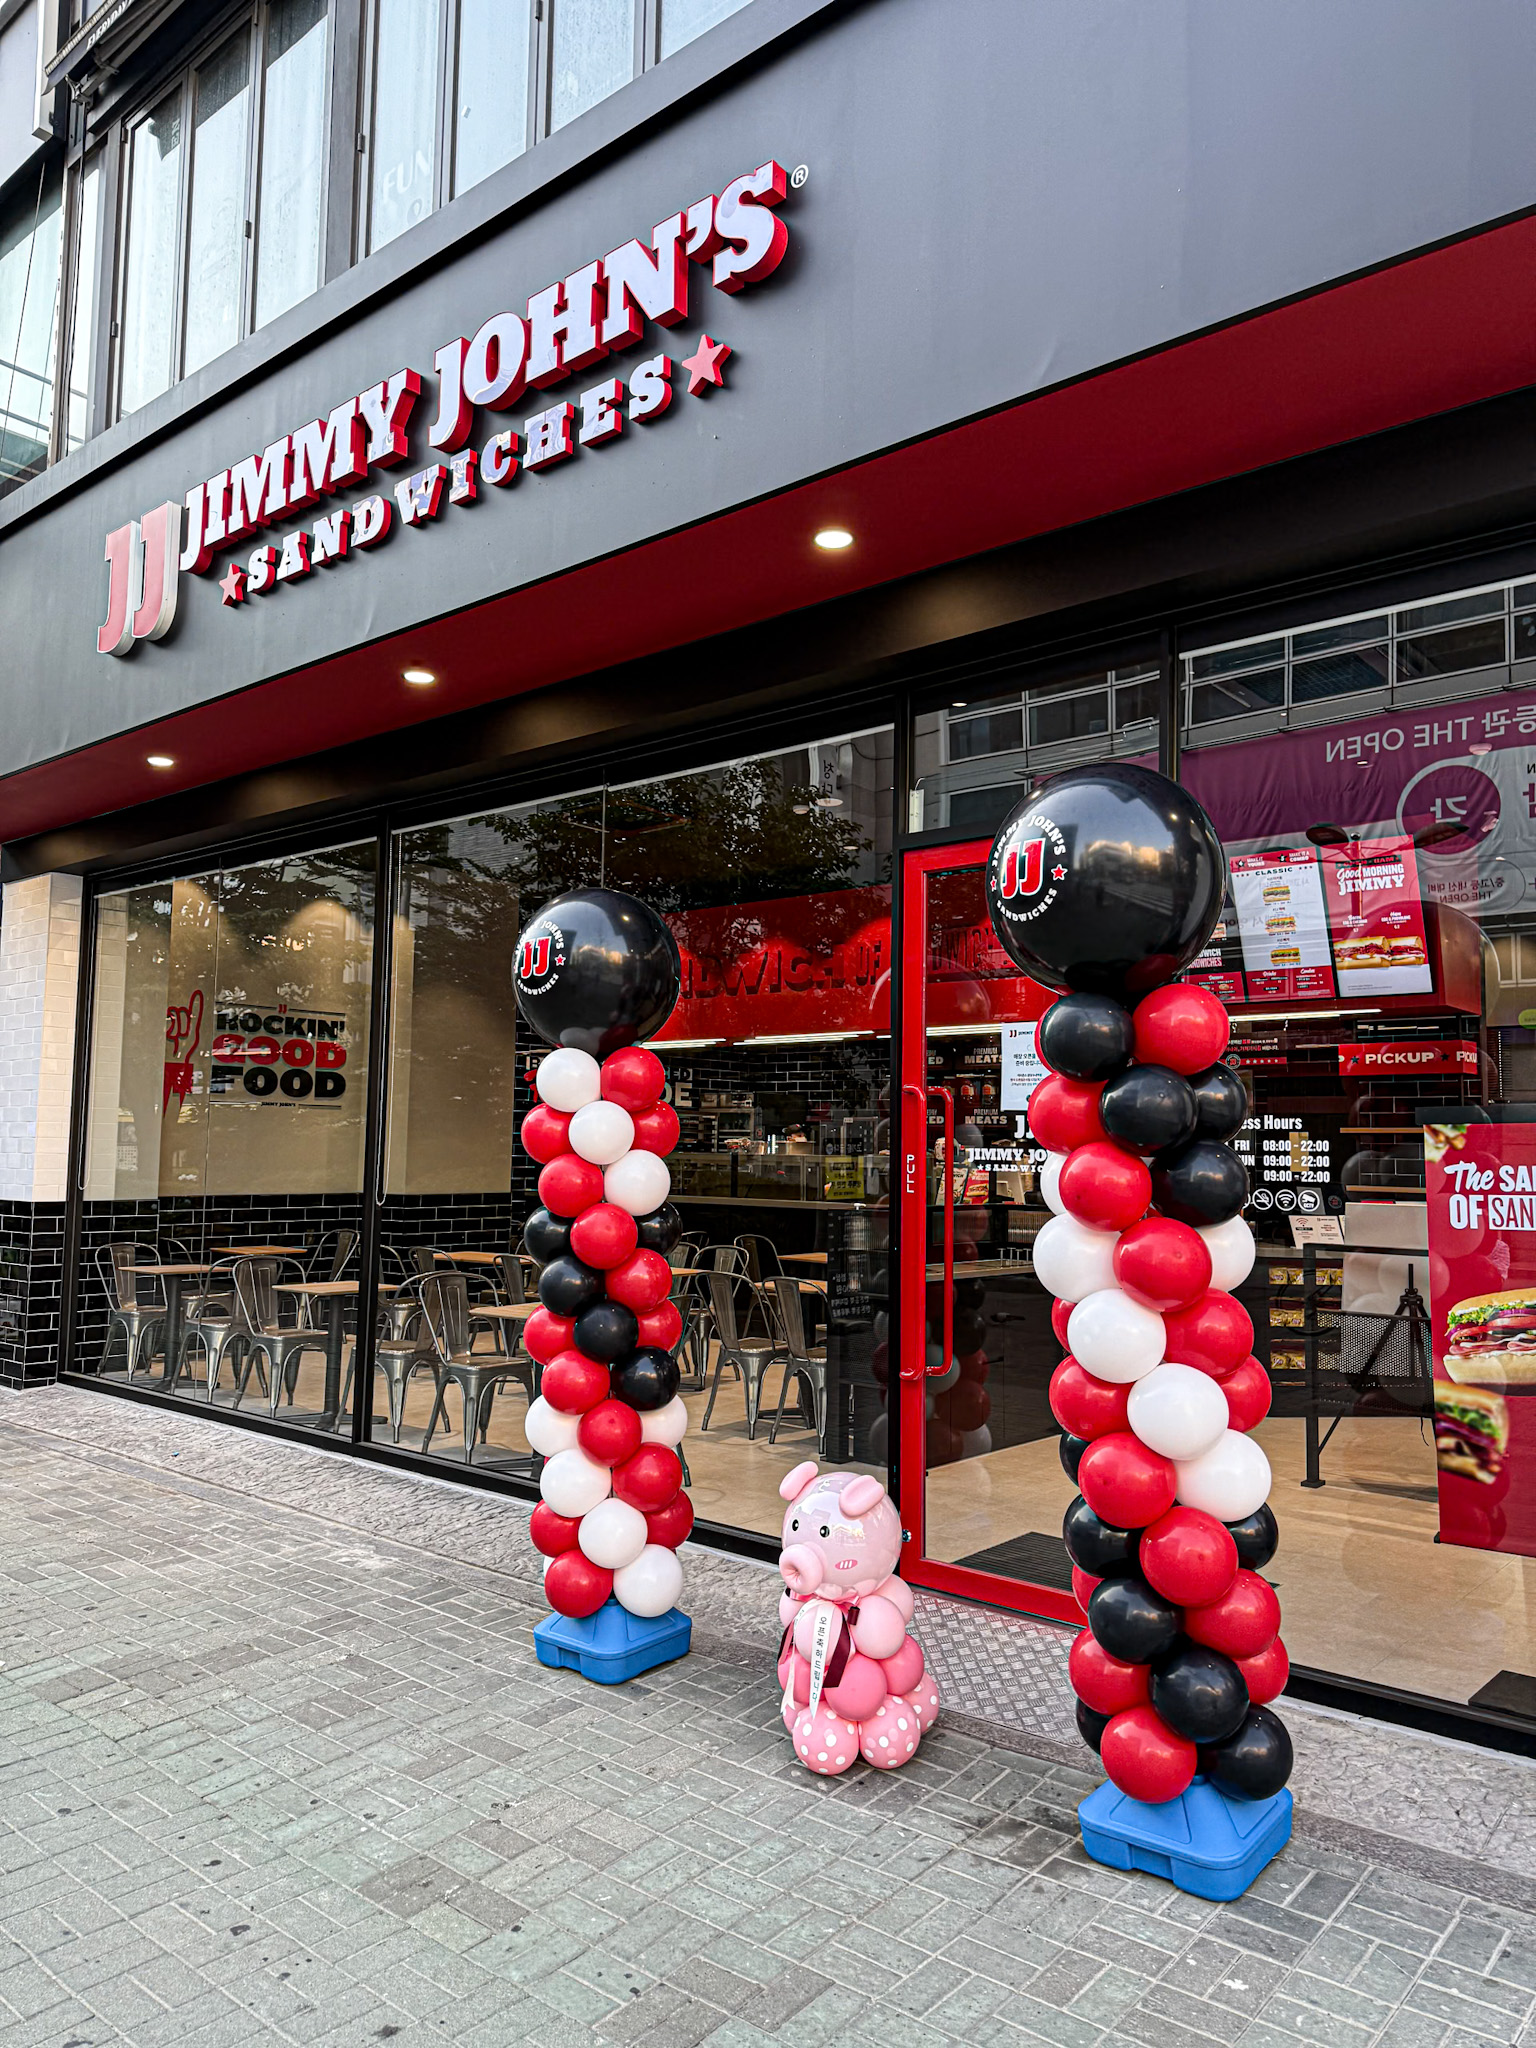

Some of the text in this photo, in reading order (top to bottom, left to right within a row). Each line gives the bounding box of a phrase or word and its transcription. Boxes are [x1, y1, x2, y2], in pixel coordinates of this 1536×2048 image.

[179, 367, 421, 575] JIMMY
[428, 159, 788, 453] JOHN'S
[247, 354, 672, 594] SANDWICHES
[97, 500, 184, 656] JJ
[1028, 815, 1066, 855] JOHN'S
[1000, 837, 1046, 899] JJ
[1255, 867, 1293, 876] CLASSIC
[1336, 864, 1404, 880] Good MORNING
[1338, 876, 1404, 896] JIMMY
[996, 888, 1057, 922] SANDWICHES
[541, 920, 564, 949] JOHN'S
[521, 936, 552, 979] JJ
[216, 1012, 345, 1039] ROCKIN'
[212, 1033, 347, 1069] GOOD
[1365, 1052, 1435, 1065] PICKUP
[210, 1065, 346, 1098] FOOD
[965, 1115, 1007, 1125] MEATS
[1264, 1115, 1302, 1130] Hours
[967, 1148, 1023, 1162] JIMMY
[1234, 1140, 1250, 1151] FRI
[1263, 1140, 1292, 1152] 08:00
[1300, 1140, 1329, 1152] 22:00
[906, 1154, 915, 1193] PULL
[1263, 1155, 1292, 1166] 09:00
[1301, 1155, 1330, 1168] 22:00
[1263, 1170, 1292, 1182] 09:00
[1301, 1171, 1330, 1183] 22:00
[1443, 1160, 1495, 1192] The
[1449, 1194, 1484, 1230] OF
